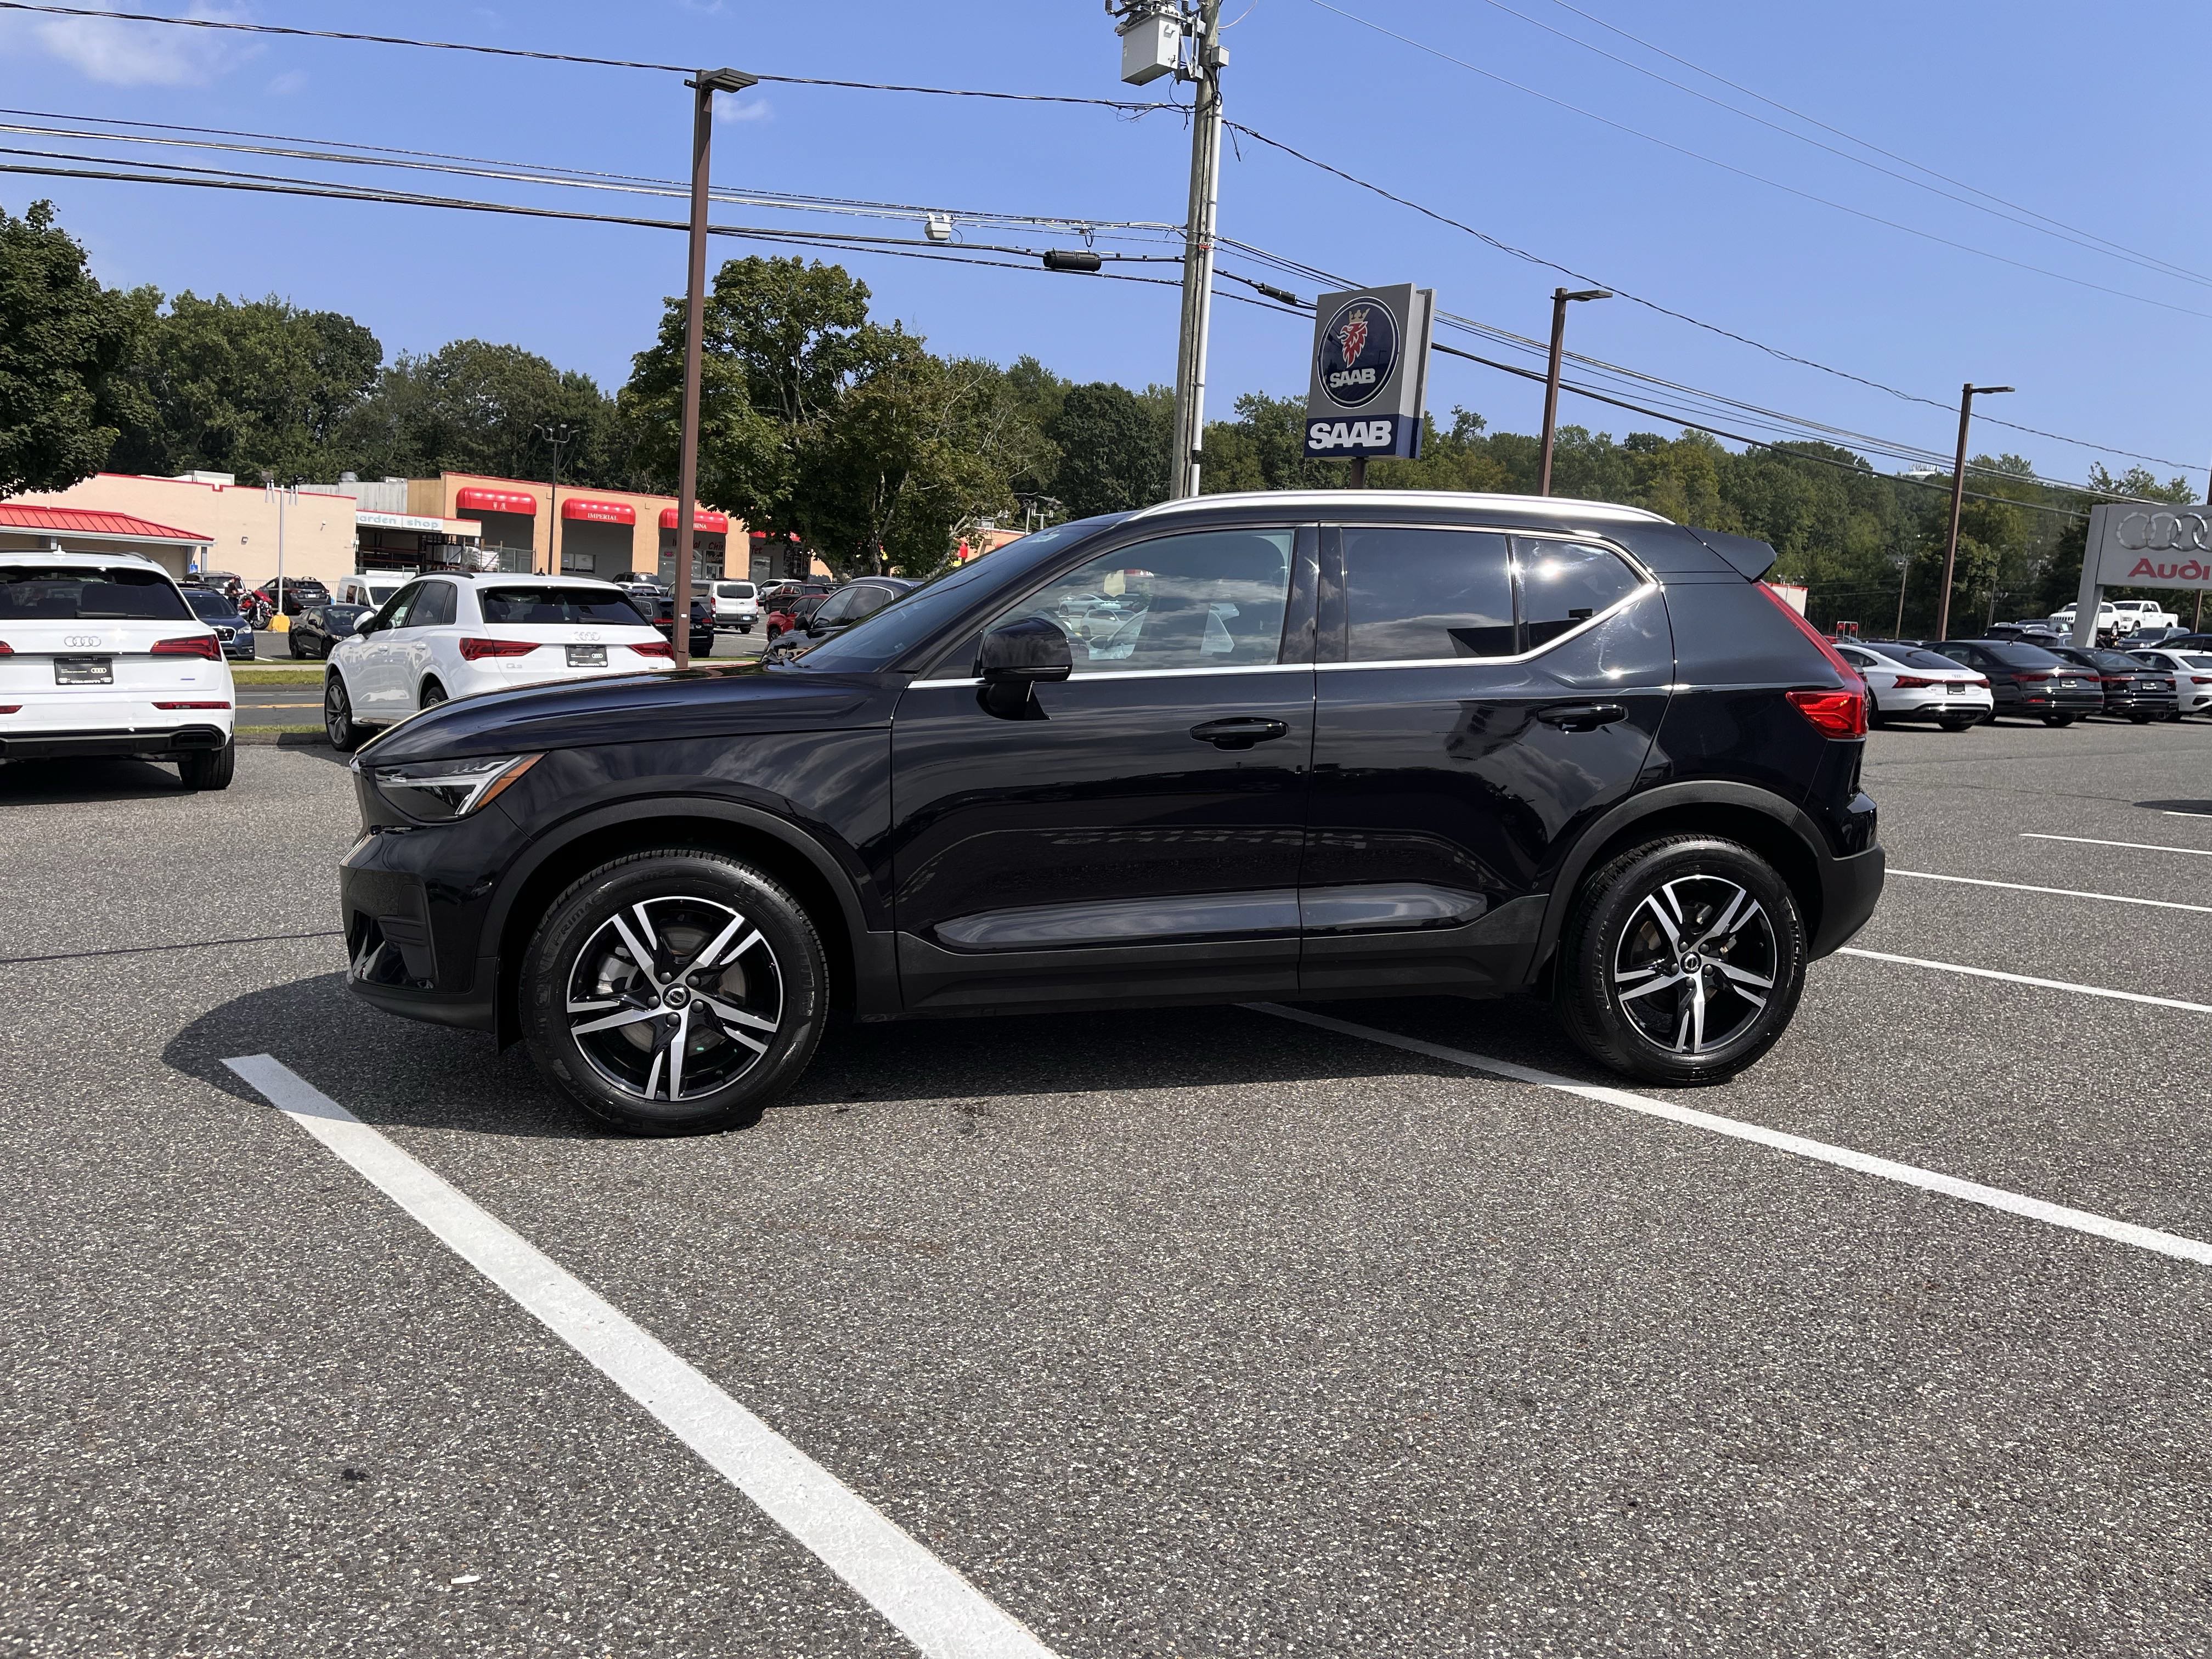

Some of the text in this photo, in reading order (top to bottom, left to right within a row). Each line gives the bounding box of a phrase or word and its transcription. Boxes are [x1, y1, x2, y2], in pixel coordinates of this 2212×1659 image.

[1330, 368, 1376, 388] SAAB
[1308, 420, 1392, 450] SAAB
[407, 518, 438, 530] shop
[587, 512, 618, 521] IMPERIAL
[2128, 557, 2210, 580] Audi
